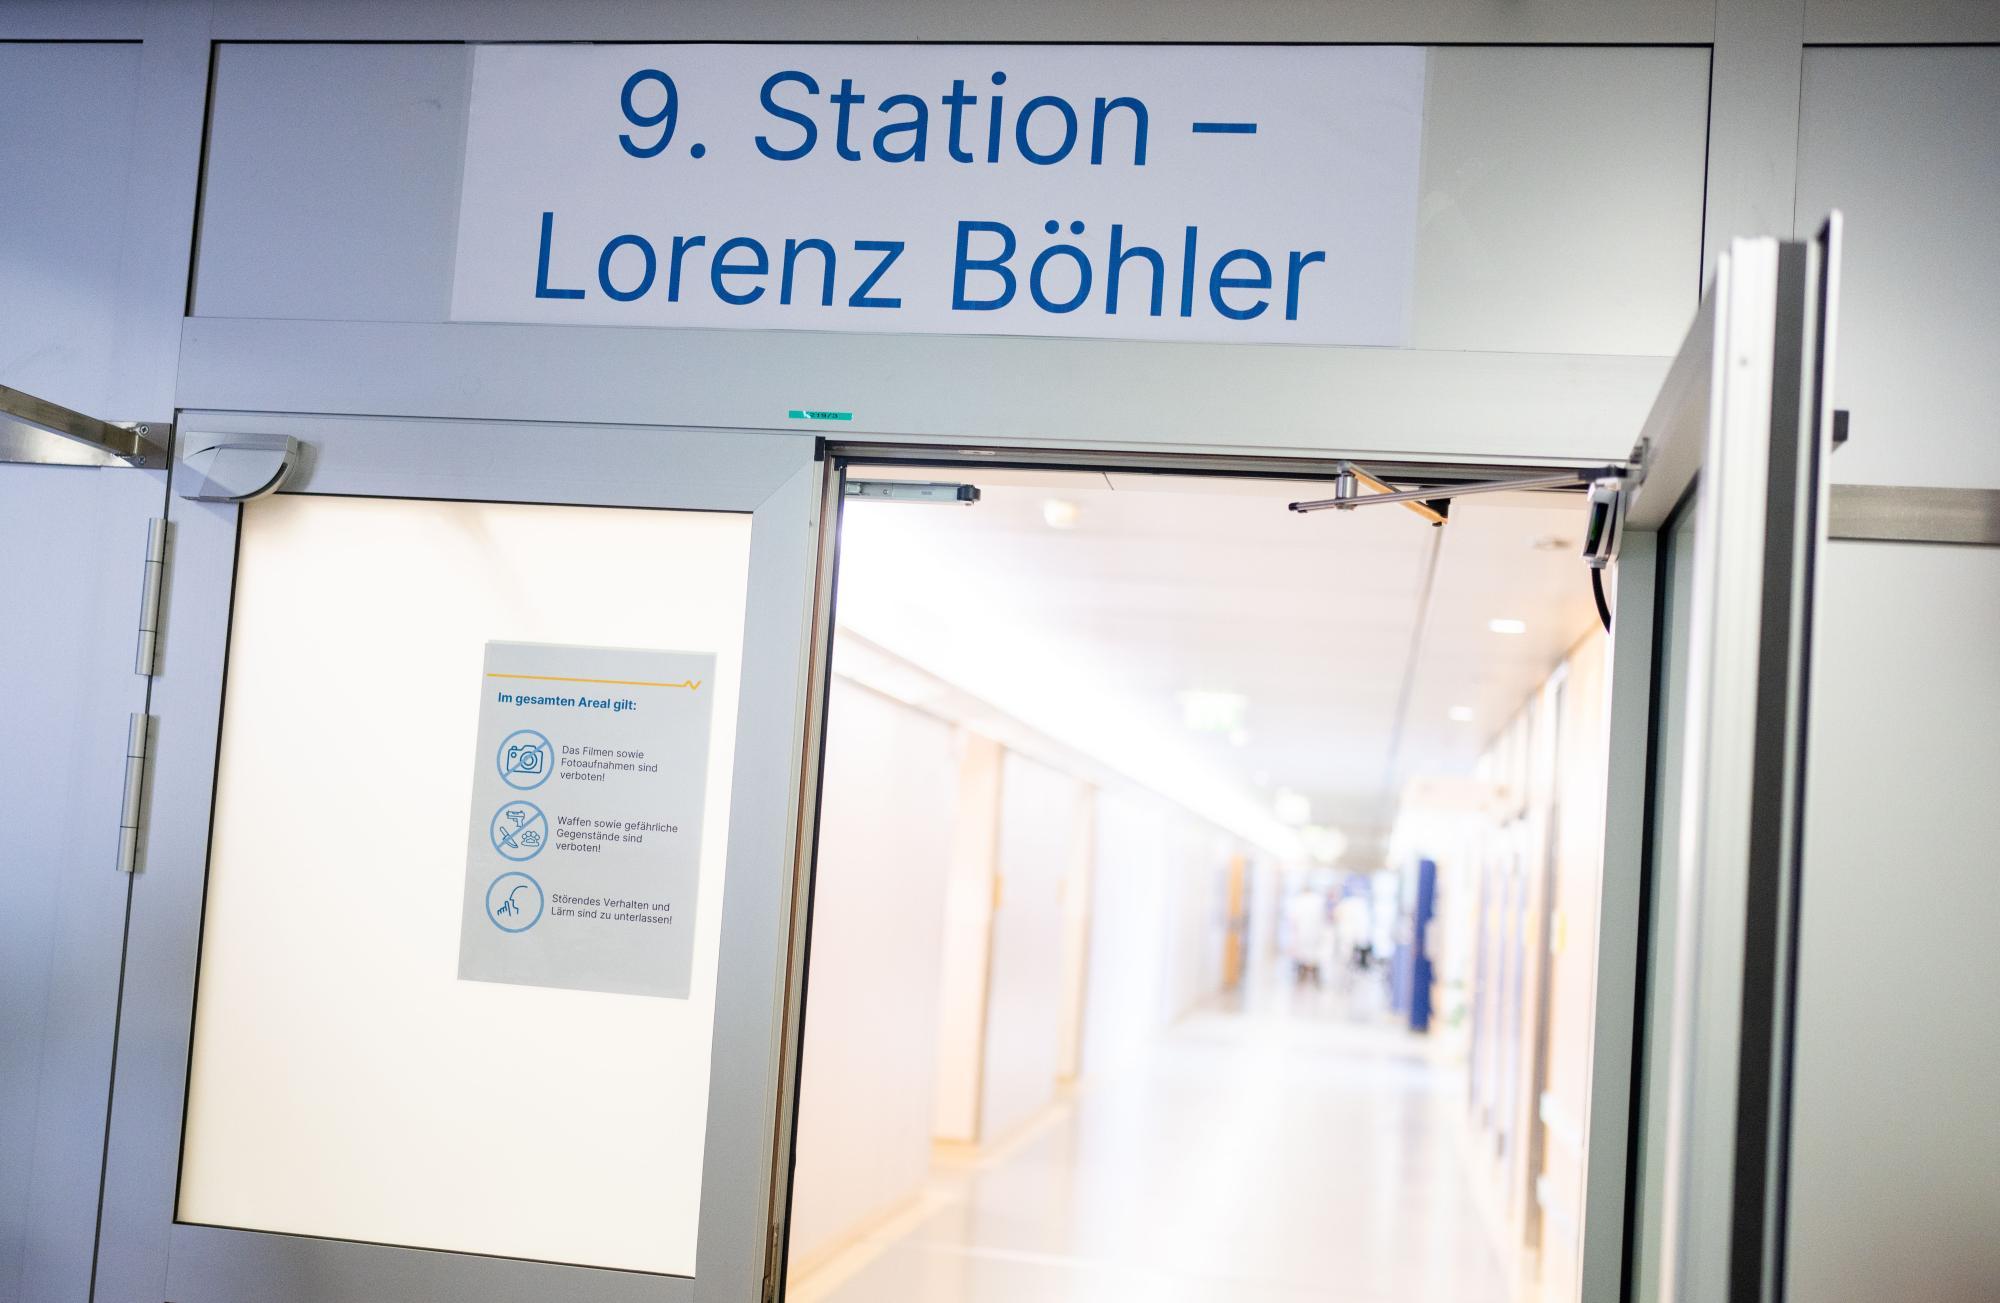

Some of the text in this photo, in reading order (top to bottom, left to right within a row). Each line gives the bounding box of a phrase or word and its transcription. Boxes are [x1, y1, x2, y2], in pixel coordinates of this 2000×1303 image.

[620, 69, 705, 159] Station
[536, 122, 1257, 308] Lorenz Böhler
[498, 692, 637, 713] Im gesamten Areal gilt:
[562, 745, 645, 760] Das Filmen sowie
[561, 757, 658, 774] Fotoaufnahmen sind
[560, 771, 606, 783] verboten!
[558, 816, 679, 834] Waffen sowie gefährliche
[557, 828, 643, 844] Gegenstände sind
[556, 841, 601, 853] verboten!
[552, 893, 671, 912] Störendes Verhalten und
[552, 906, 673, 926] Lärm sind zu unterlassen!
[614, 913, 673, 926] 9.
